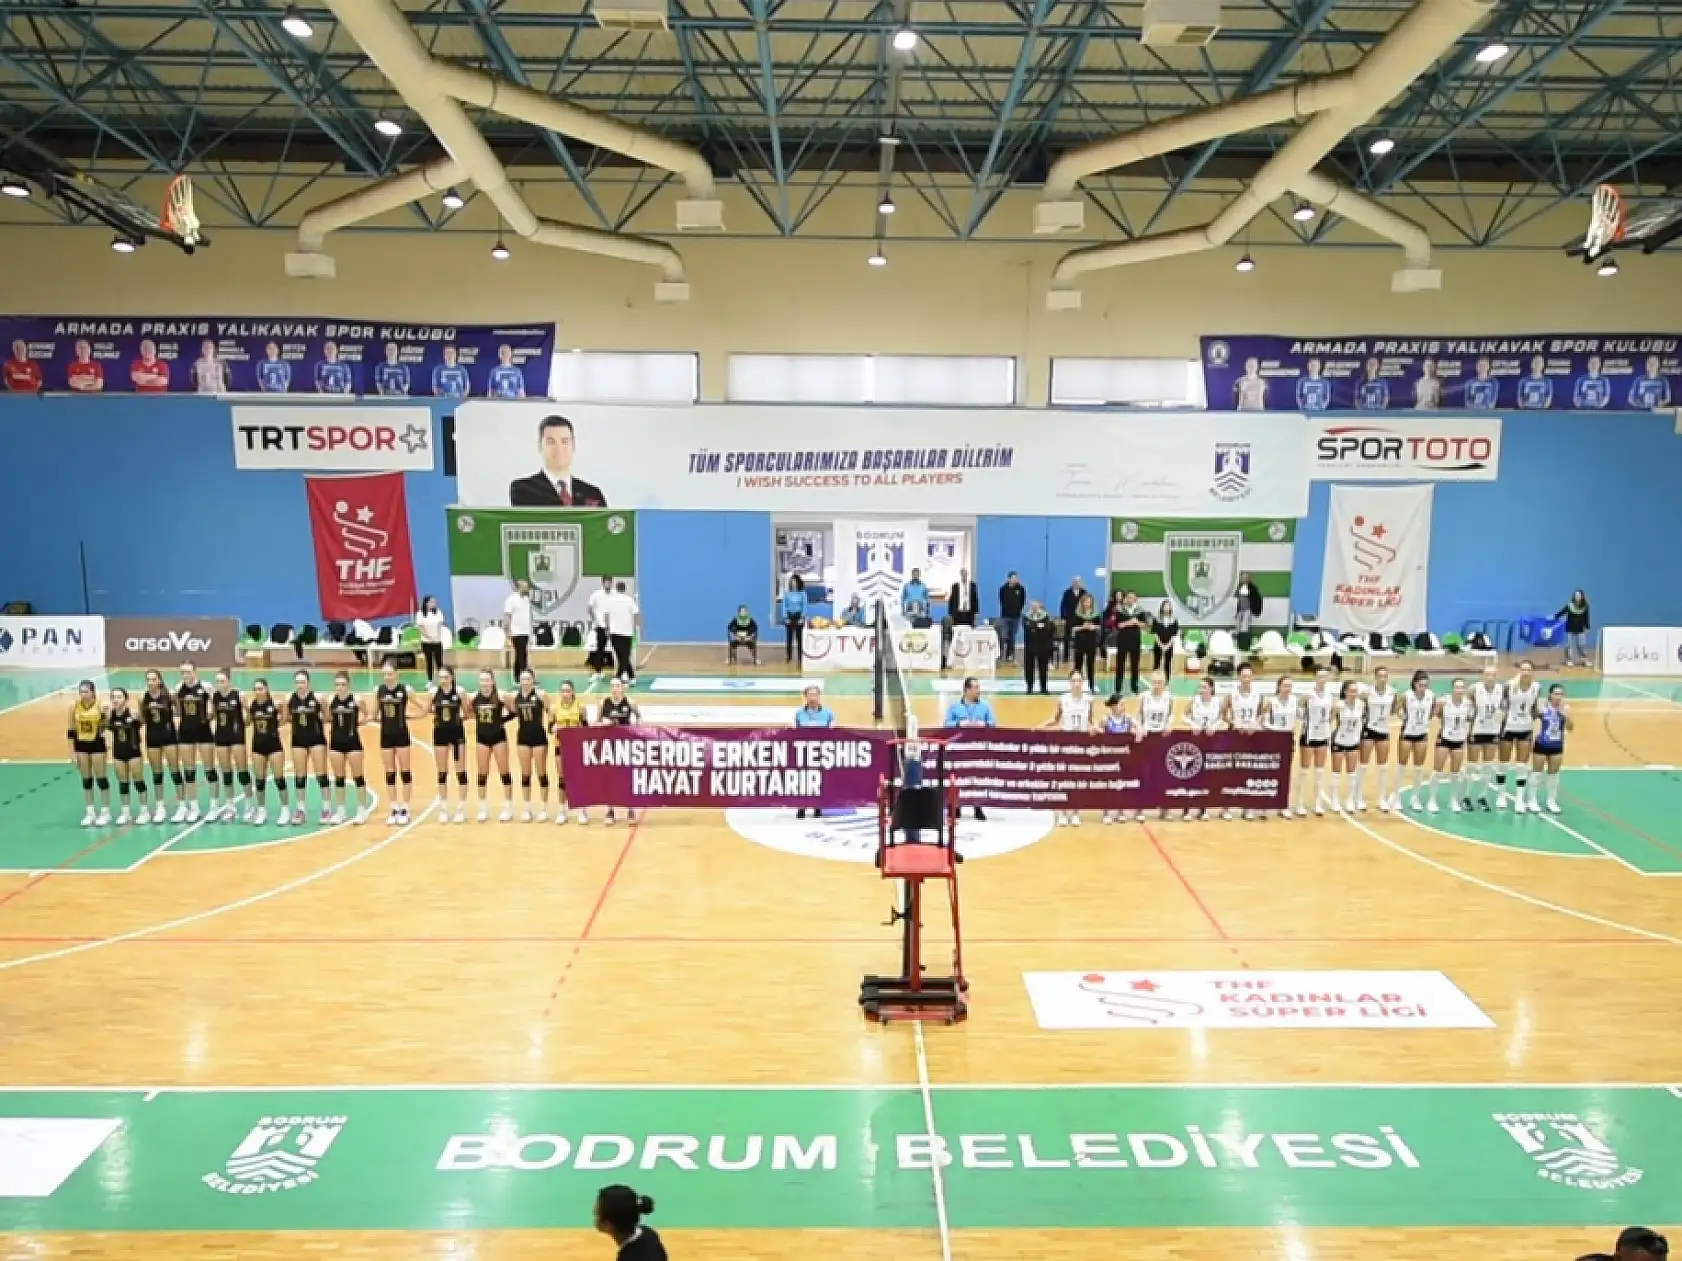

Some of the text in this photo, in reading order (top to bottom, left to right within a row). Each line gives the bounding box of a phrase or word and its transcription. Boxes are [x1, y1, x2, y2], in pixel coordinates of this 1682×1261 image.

[54, 322, 134, 336] ARMADA
[141, 322, 209, 336] PRAXIS
[217, 322, 319, 338] YALIKAVAK
[325, 324, 375, 339] SPOR
[1290, 341, 1366, 355] ARMADA
[1373, 340, 1440, 355] PRAXIS
[1447, 340, 1546, 354] YALIKAVAK
[1550, 339, 1600, 353] SPOR
[689, 443, 1013, 473] TÜM SPORCULARIMIZA BAŞARILAR DİLERİM
[743, 476, 782, 488] WISH
[785, 475, 849, 487] SUCCESS
[854, 474, 873, 486] TO
[874, 474, 898, 485] ALL
[902, 472, 963, 485] PLAYERS
[336, 556, 392, 580] THF
[22, 627, 82, 646] PAN
[582, 739, 705, 768] KANSERDE
[712, 740, 790, 769] ERKEN
[632, 769, 822, 798] HAYAT KURTARIR
[1219, 993, 1402, 1003] KADINLAR
[436, 1123, 1421, 1170] BODRUM BELEDİYESİ
